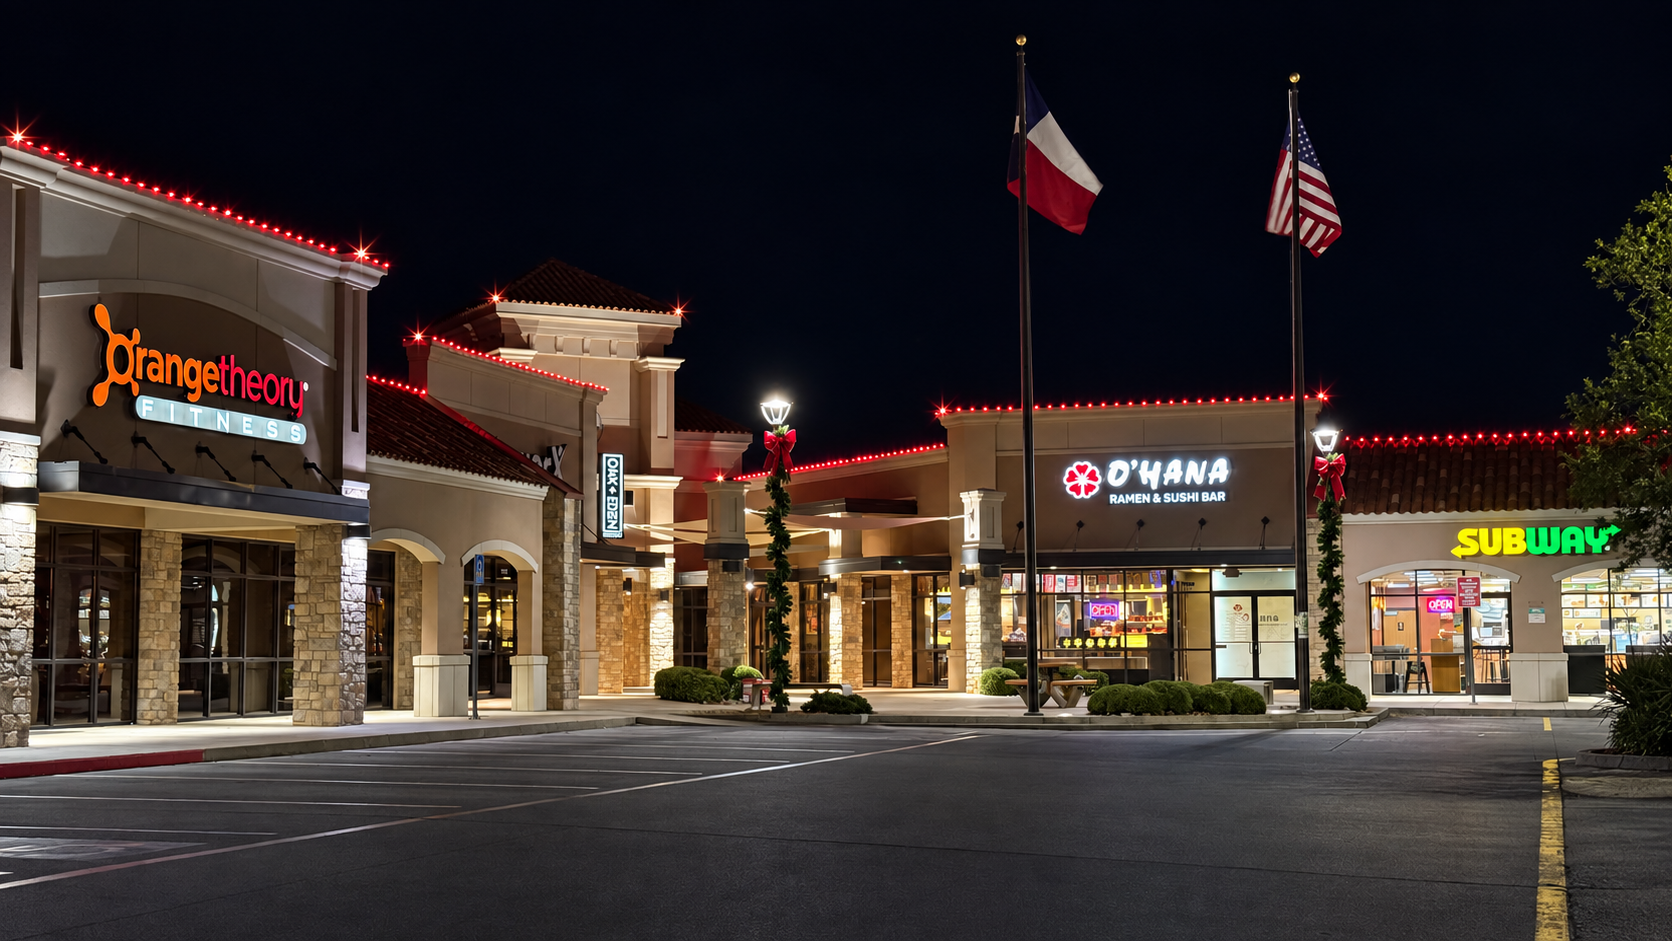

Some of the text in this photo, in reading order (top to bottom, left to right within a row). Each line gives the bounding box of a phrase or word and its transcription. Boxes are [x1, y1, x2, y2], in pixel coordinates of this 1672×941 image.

[142, 399, 302, 443] FITNESS
[1107, 458, 1229, 490] O'HANA
[607, 496, 618, 529] EDEN
[1109, 491, 1226, 505] RAMEN & SUSHI BAR
[1450, 524, 1621, 558] SUBWAY
[1428, 598, 1453, 610] OPEN
